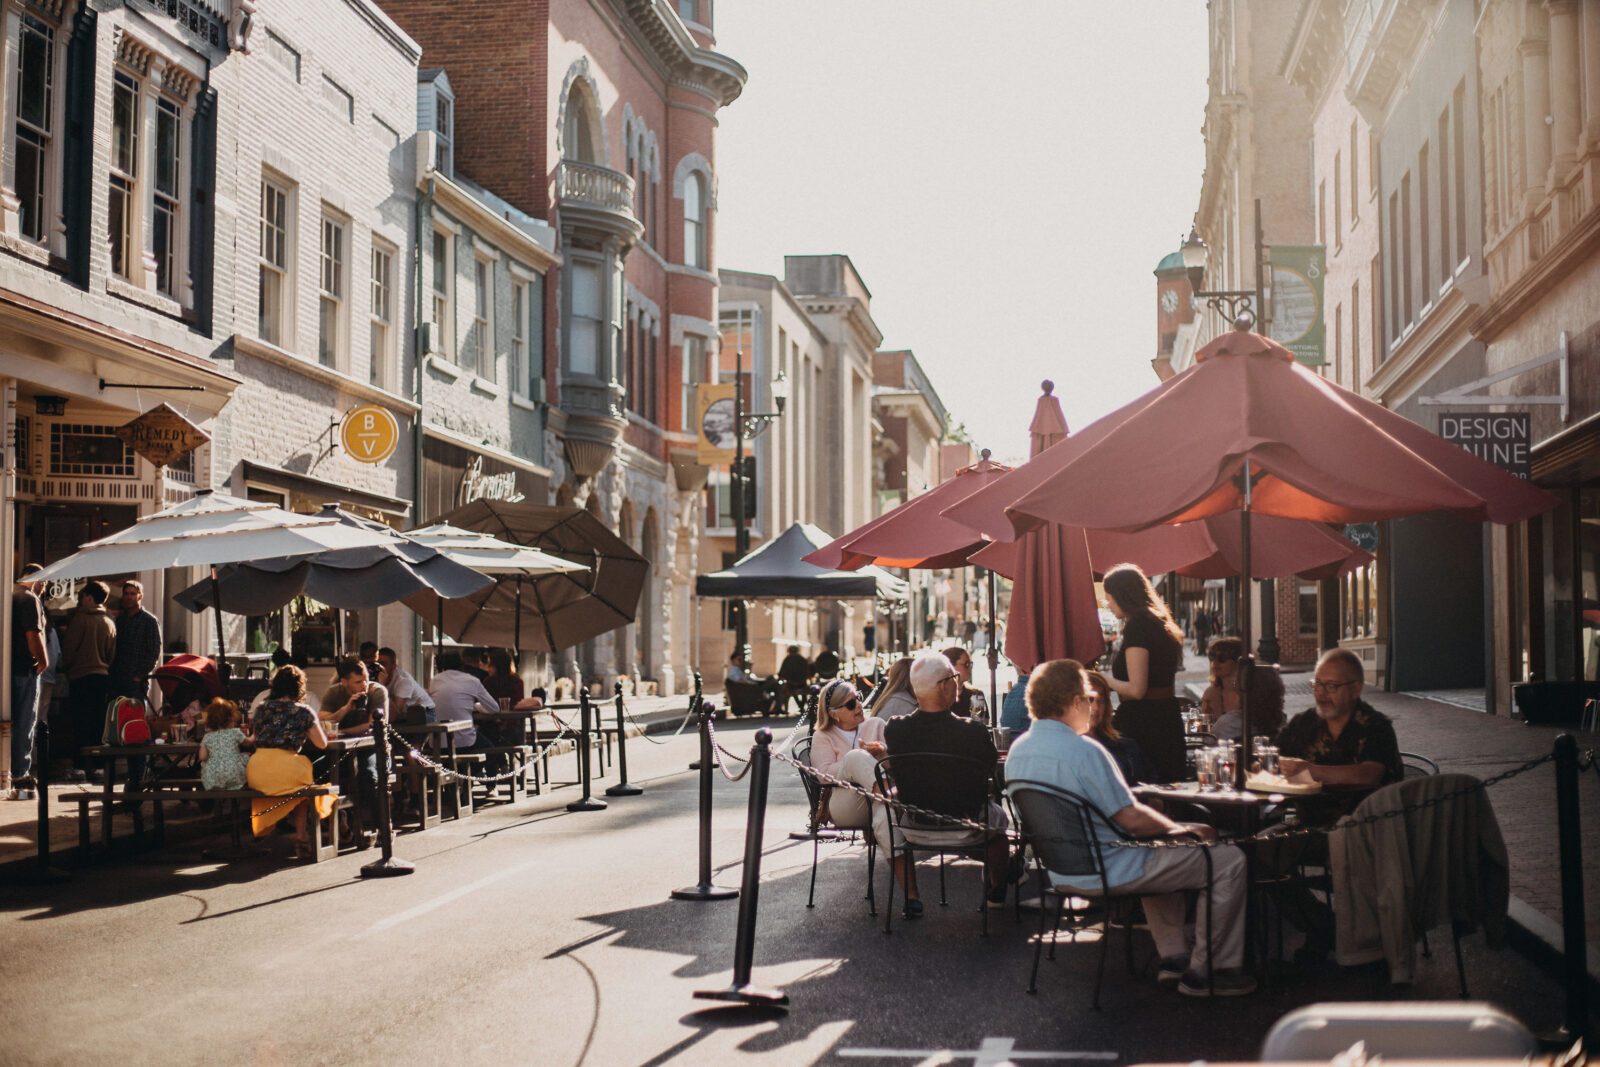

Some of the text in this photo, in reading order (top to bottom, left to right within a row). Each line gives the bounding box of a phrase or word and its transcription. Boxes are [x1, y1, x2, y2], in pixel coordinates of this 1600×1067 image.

[364, 414, 375, 430] B
[1442, 417, 1527, 439] DESIGN
[132, 422, 188, 446] REMEDY
[363, 439, 376, 455] V
